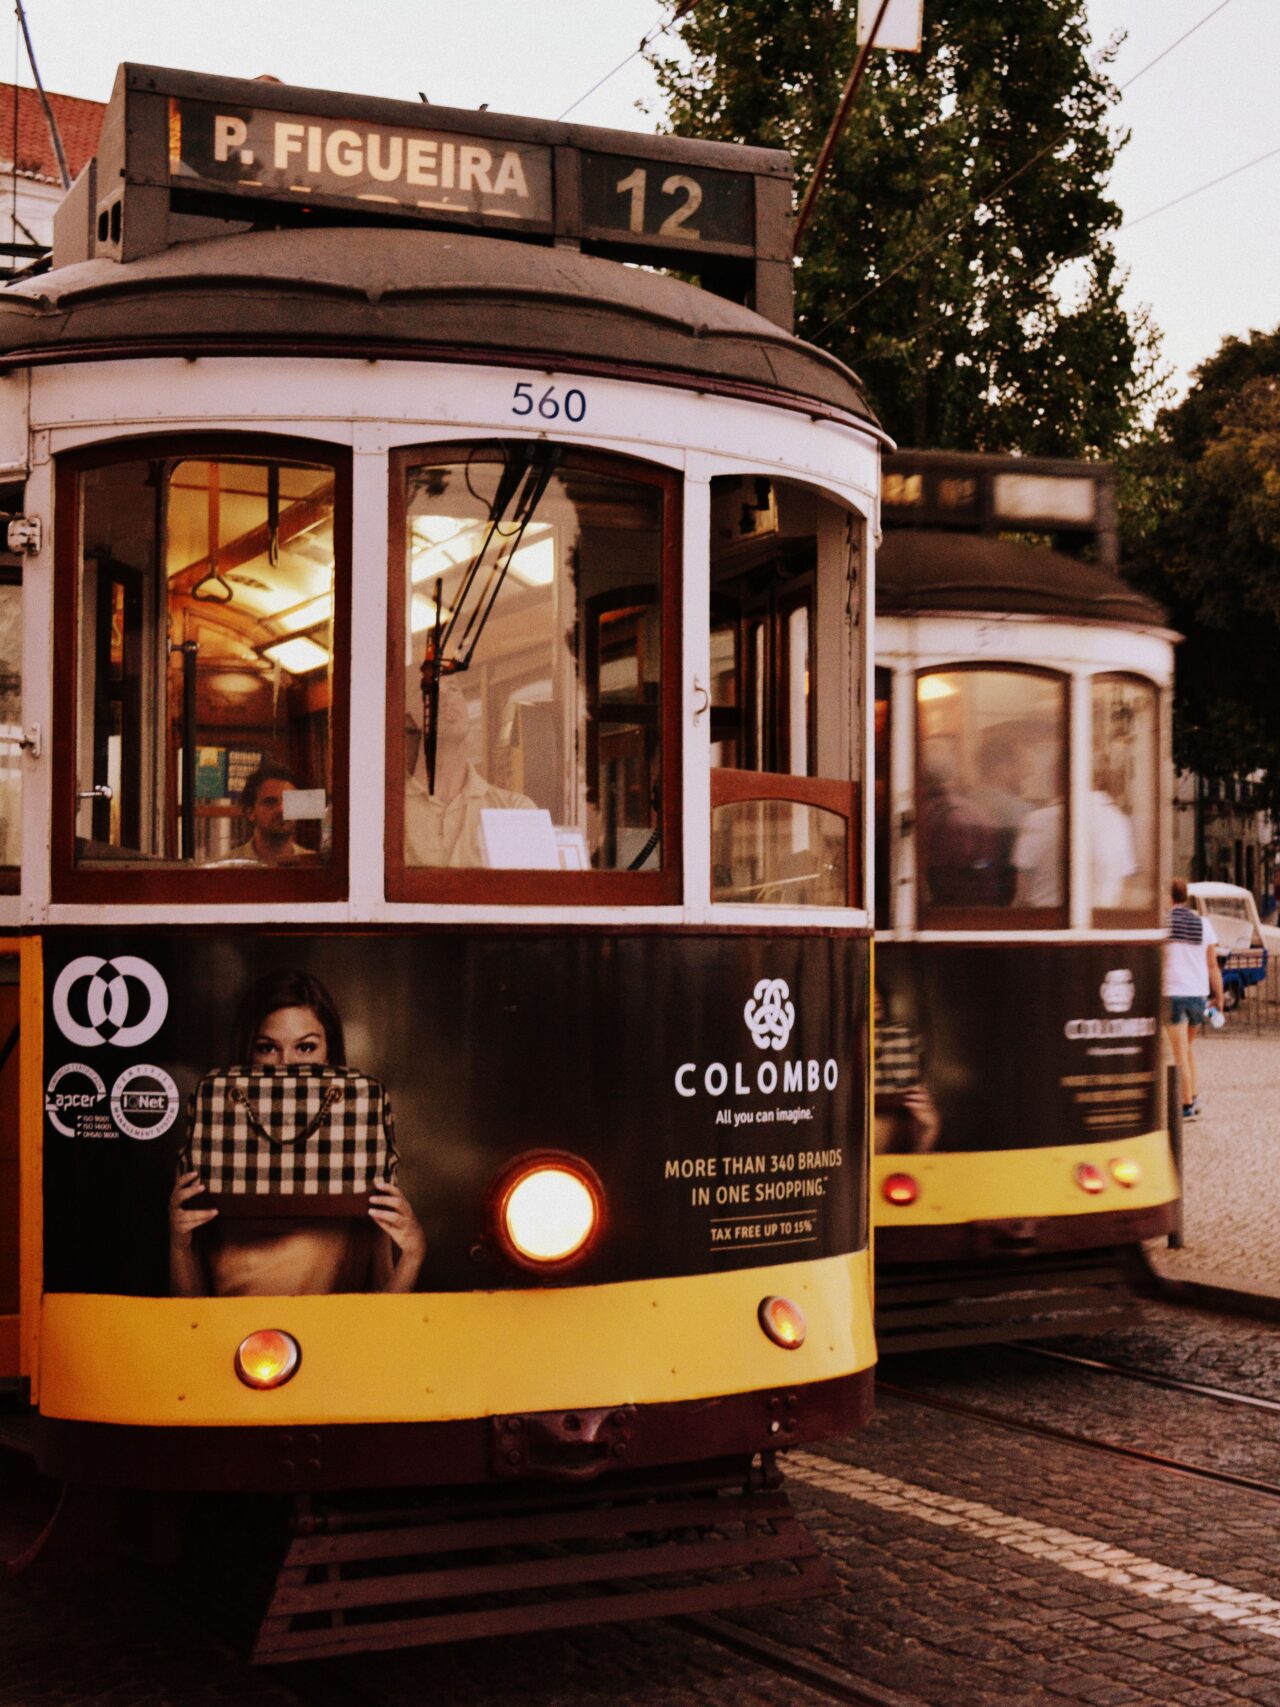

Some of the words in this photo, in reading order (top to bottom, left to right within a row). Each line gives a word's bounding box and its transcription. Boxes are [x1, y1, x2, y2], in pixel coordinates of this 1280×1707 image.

[213, 114, 255, 166] P.
[273, 121, 530, 198] FIGUEIRA
[615, 168, 704, 240] 12
[511, 381, 588, 422] 560
[674, 1058, 839, 1097] COLOMBO
[55, 1093, 97, 1112] apcer
[715, 1109, 732, 1124] All
[734, 1112, 754, 1128] you
[755, 1111, 775, 1123] can
[665, 1158, 717, 1179] MORE
[722, 1155, 766, 1176] THAN
[770, 1154, 795, 1173] 340
[798, 1148, 843, 1170] BRANDS
[691, 1186, 710, 1206] IN
[716, 1184, 751, 1205] ONE
[711, 1228, 732, 1241] TAX
[734, 1225, 762, 1239] FREE
[763, 1223, 779, 1237] UP
[779, 1222, 793, 1235] TO
